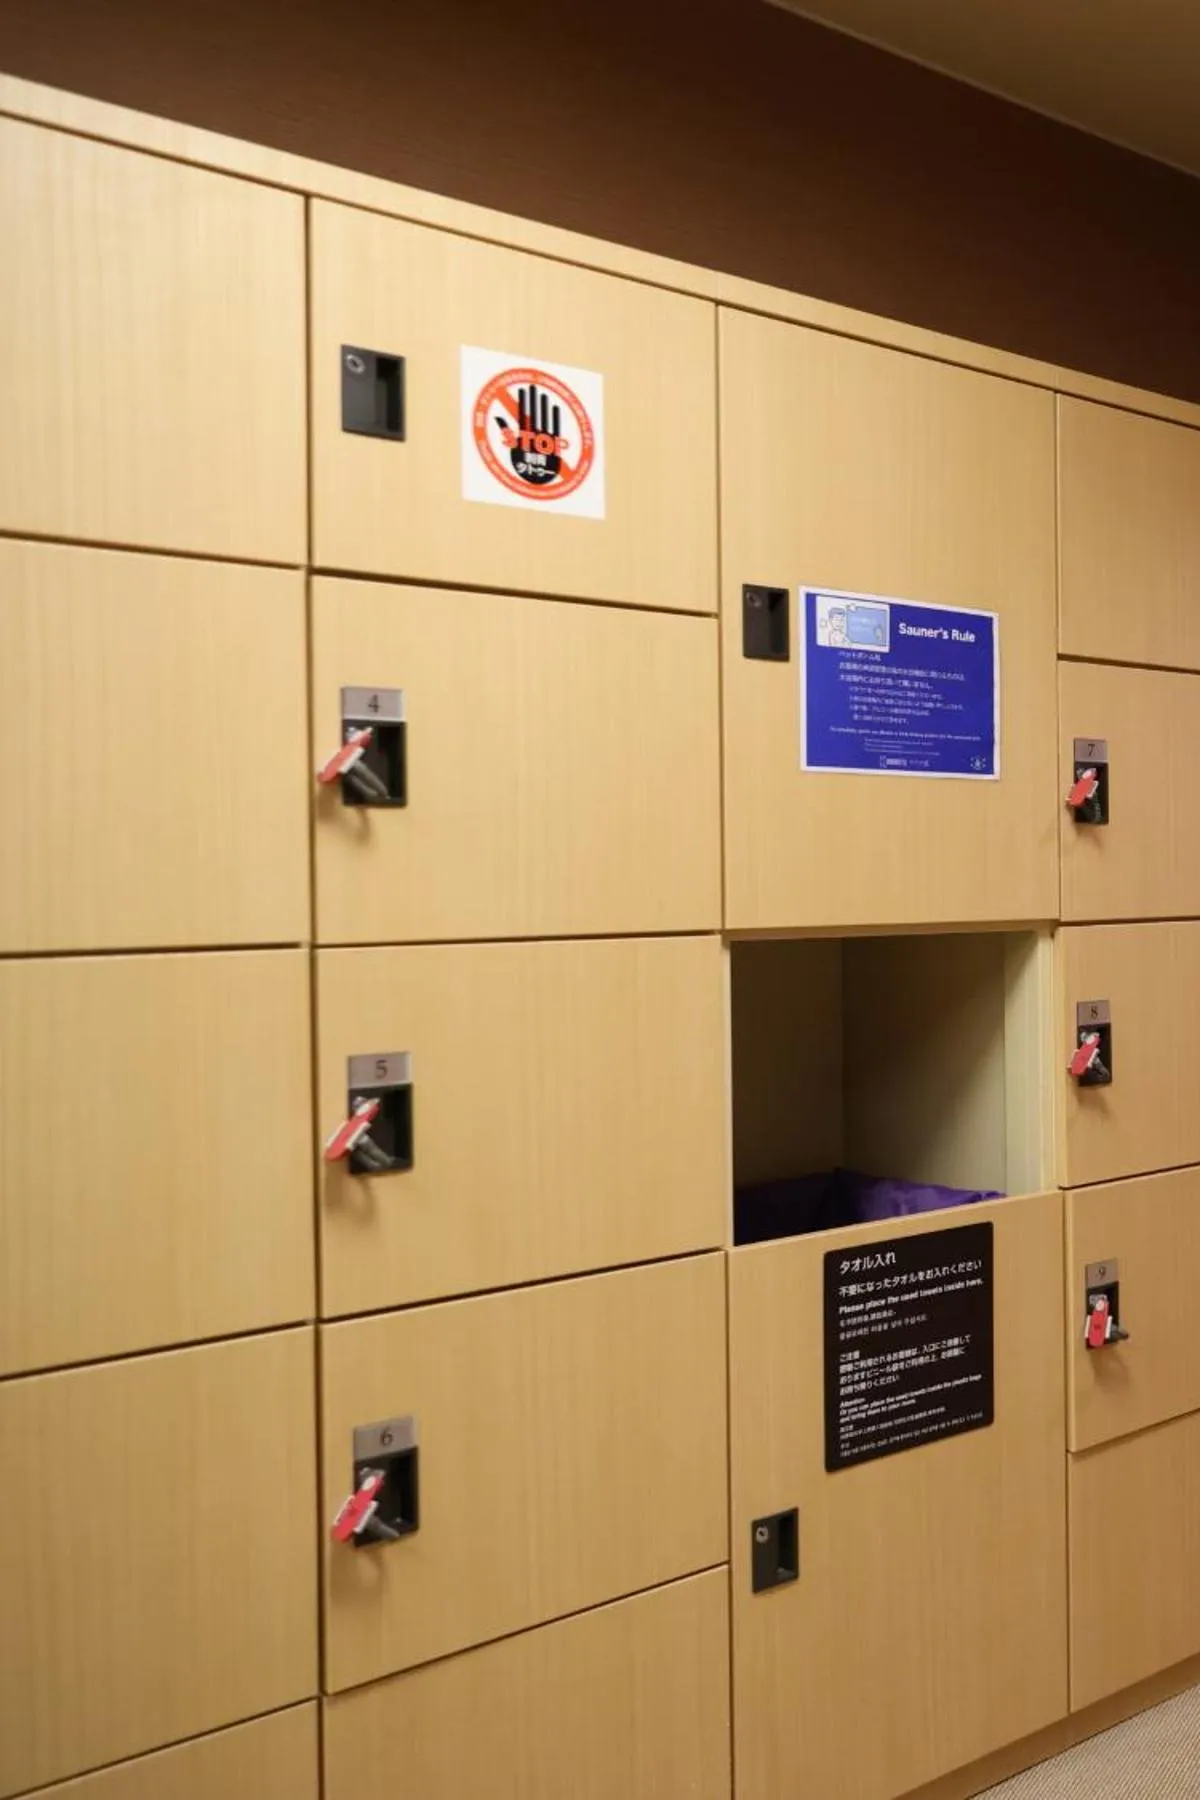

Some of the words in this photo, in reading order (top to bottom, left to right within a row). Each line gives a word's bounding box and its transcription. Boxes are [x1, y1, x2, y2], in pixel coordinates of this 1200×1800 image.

[502, 427, 569, 455] STOP
[898, 622, 949, 640] Sauner's
[951, 628, 976, 643] Rule
[368, 694, 380, 713] 4
[1087, 743, 1096, 757] 7
[375, 1059, 388, 1080] 5
[839, 1251, 897, 1275] タオル入れ
[838, 1303, 865, 1315] Please
[865, 1299, 886, 1311] place
[887, 1295, 900, 1305] the
[380, 1427, 393, 1447] 6
